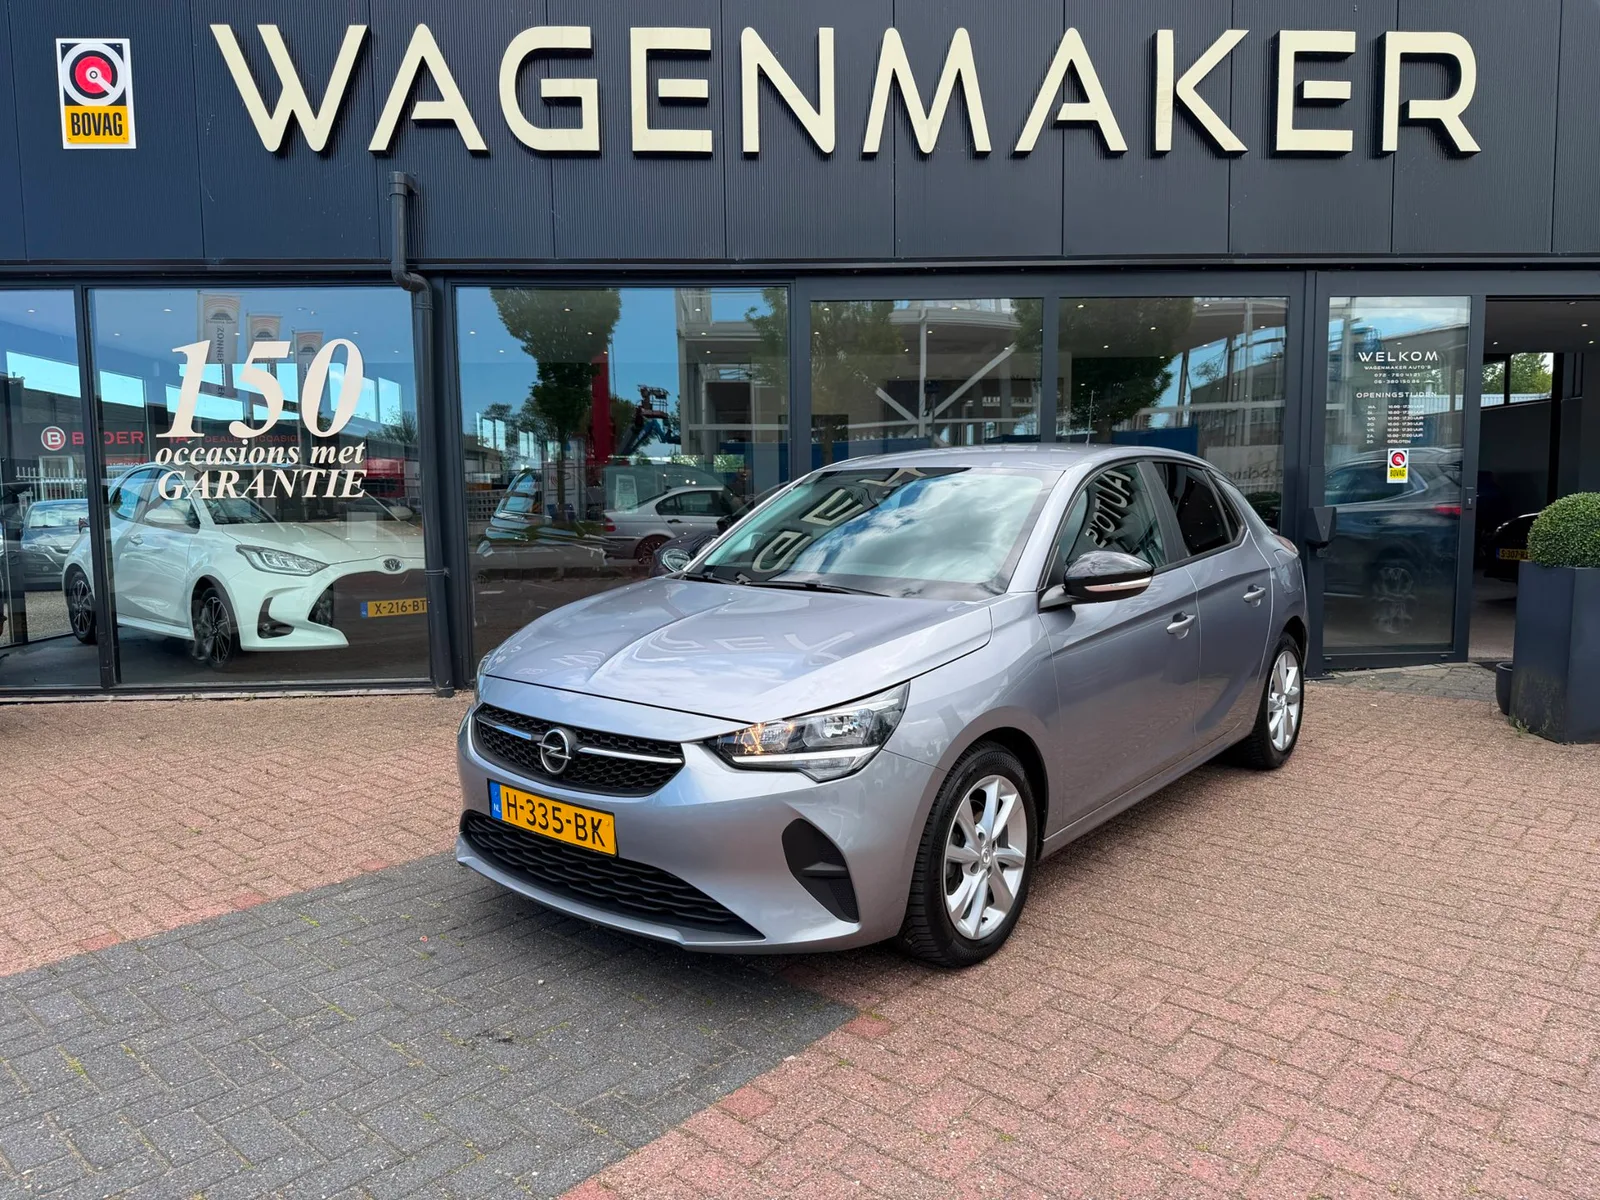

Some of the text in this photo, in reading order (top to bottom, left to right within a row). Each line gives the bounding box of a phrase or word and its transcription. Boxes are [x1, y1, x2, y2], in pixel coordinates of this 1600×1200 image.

[210, 24, 1481, 155] WAGENMAKER
[70, 112, 123, 136] BOVAG
[1358, 351, 1438, 362] WELKOM
[156, 338, 364, 438] 150
[155, 440, 300, 466] occasions
[310, 442, 366, 465] met
[158, 469, 367, 500] GARANTIE
[375, 600, 426, 615] X-216-BT
[493, 803, 501, 813] NL
[506, 792, 606, 847] H-335-BK
